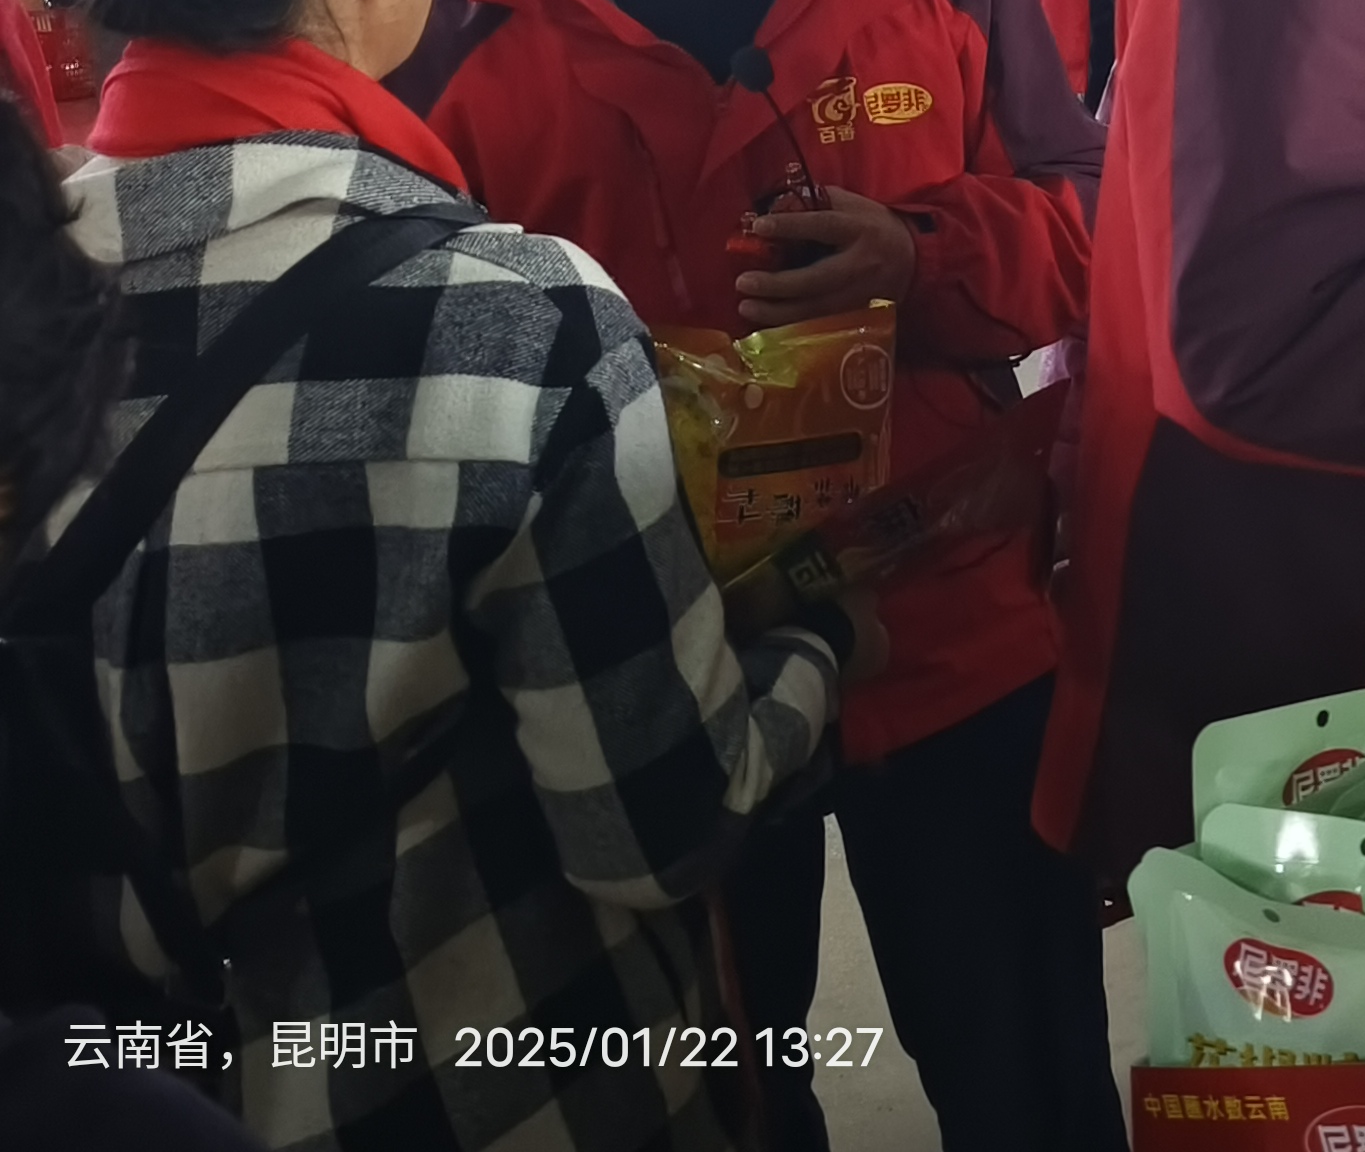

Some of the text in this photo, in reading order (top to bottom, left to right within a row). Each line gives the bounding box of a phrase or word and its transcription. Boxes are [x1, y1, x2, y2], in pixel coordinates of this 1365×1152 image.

[866, 88, 924, 116] 尼罗非
[1238, 942, 1331, 1008] 尼罗非
[1142, 1093, 1290, 1122] 中国蘸水数云南
